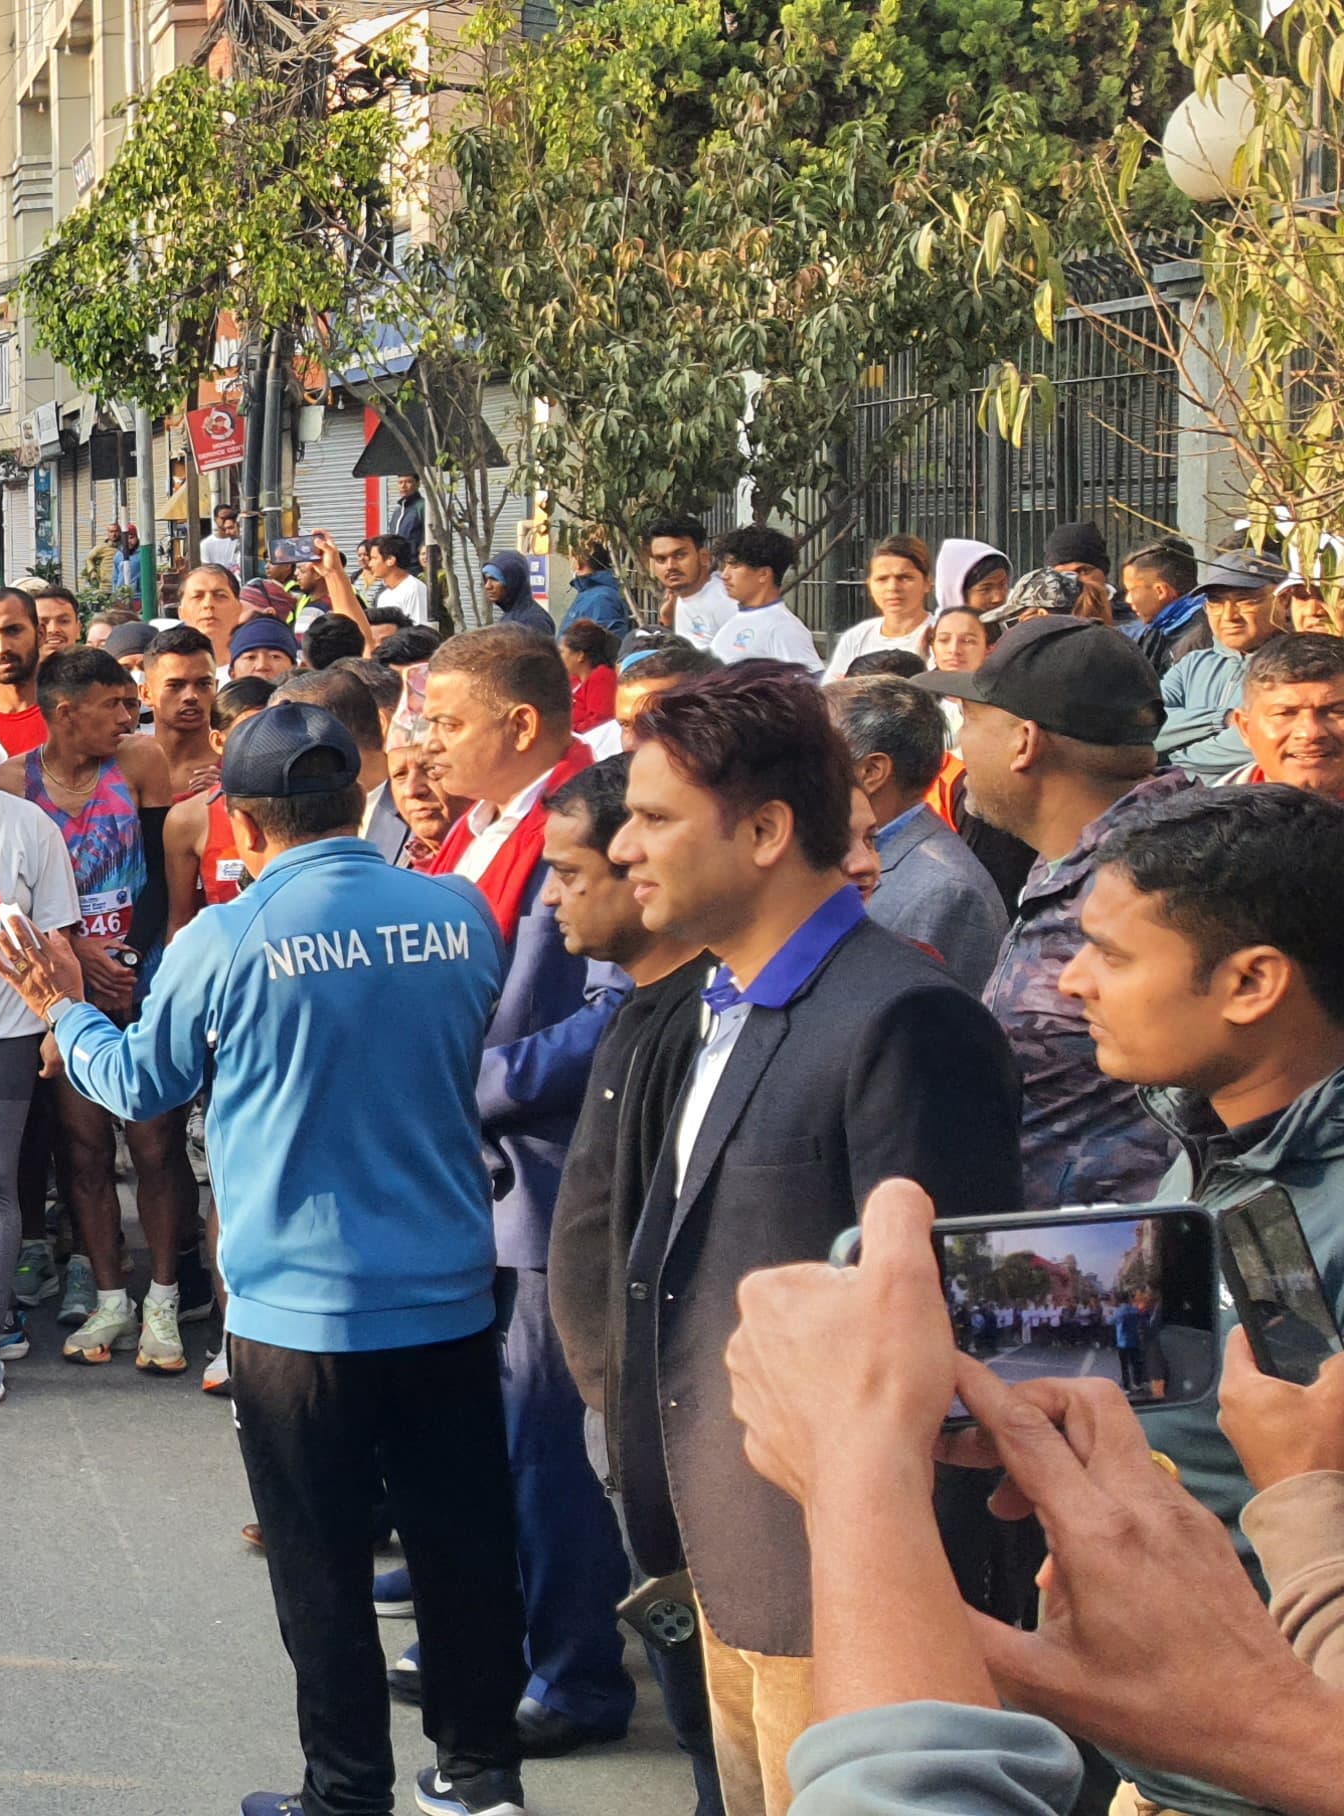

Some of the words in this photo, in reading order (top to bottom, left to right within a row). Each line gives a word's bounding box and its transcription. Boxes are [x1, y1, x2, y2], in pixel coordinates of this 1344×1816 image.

[78, 912, 121, 937] 346
[263, 928, 372, 980] NRNA
[376, 921, 470, 965] TEAM
